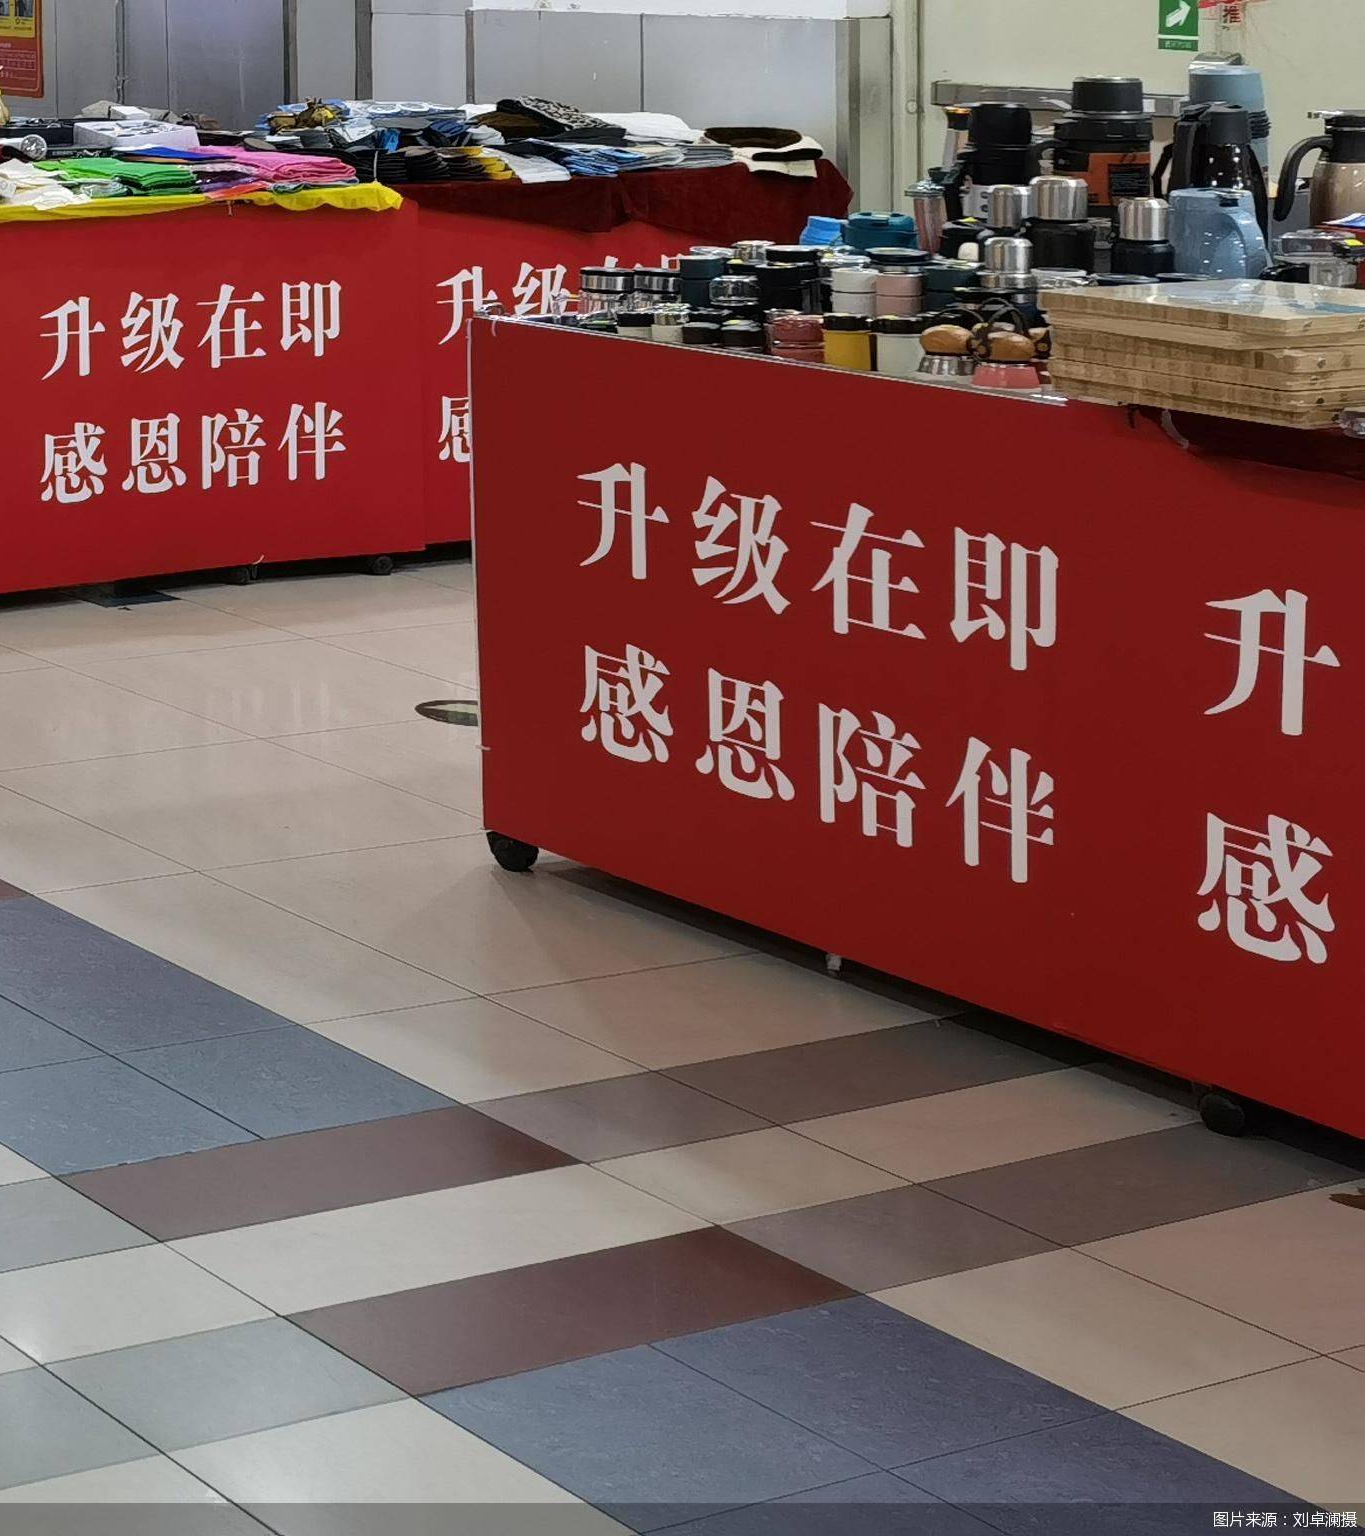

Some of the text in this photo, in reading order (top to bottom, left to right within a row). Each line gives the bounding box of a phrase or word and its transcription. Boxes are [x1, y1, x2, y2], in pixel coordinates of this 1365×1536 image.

[39, 279, 342, 382] 升级在即
[39, 401, 348, 504] 感恩陪伴
[576, 462, 1059, 671] 升级在即
[1203, 588, 1342, 736] 升
[579, 642, 1055, 884] 感恩陪伴
[1196, 811, 1336, 964] 感
